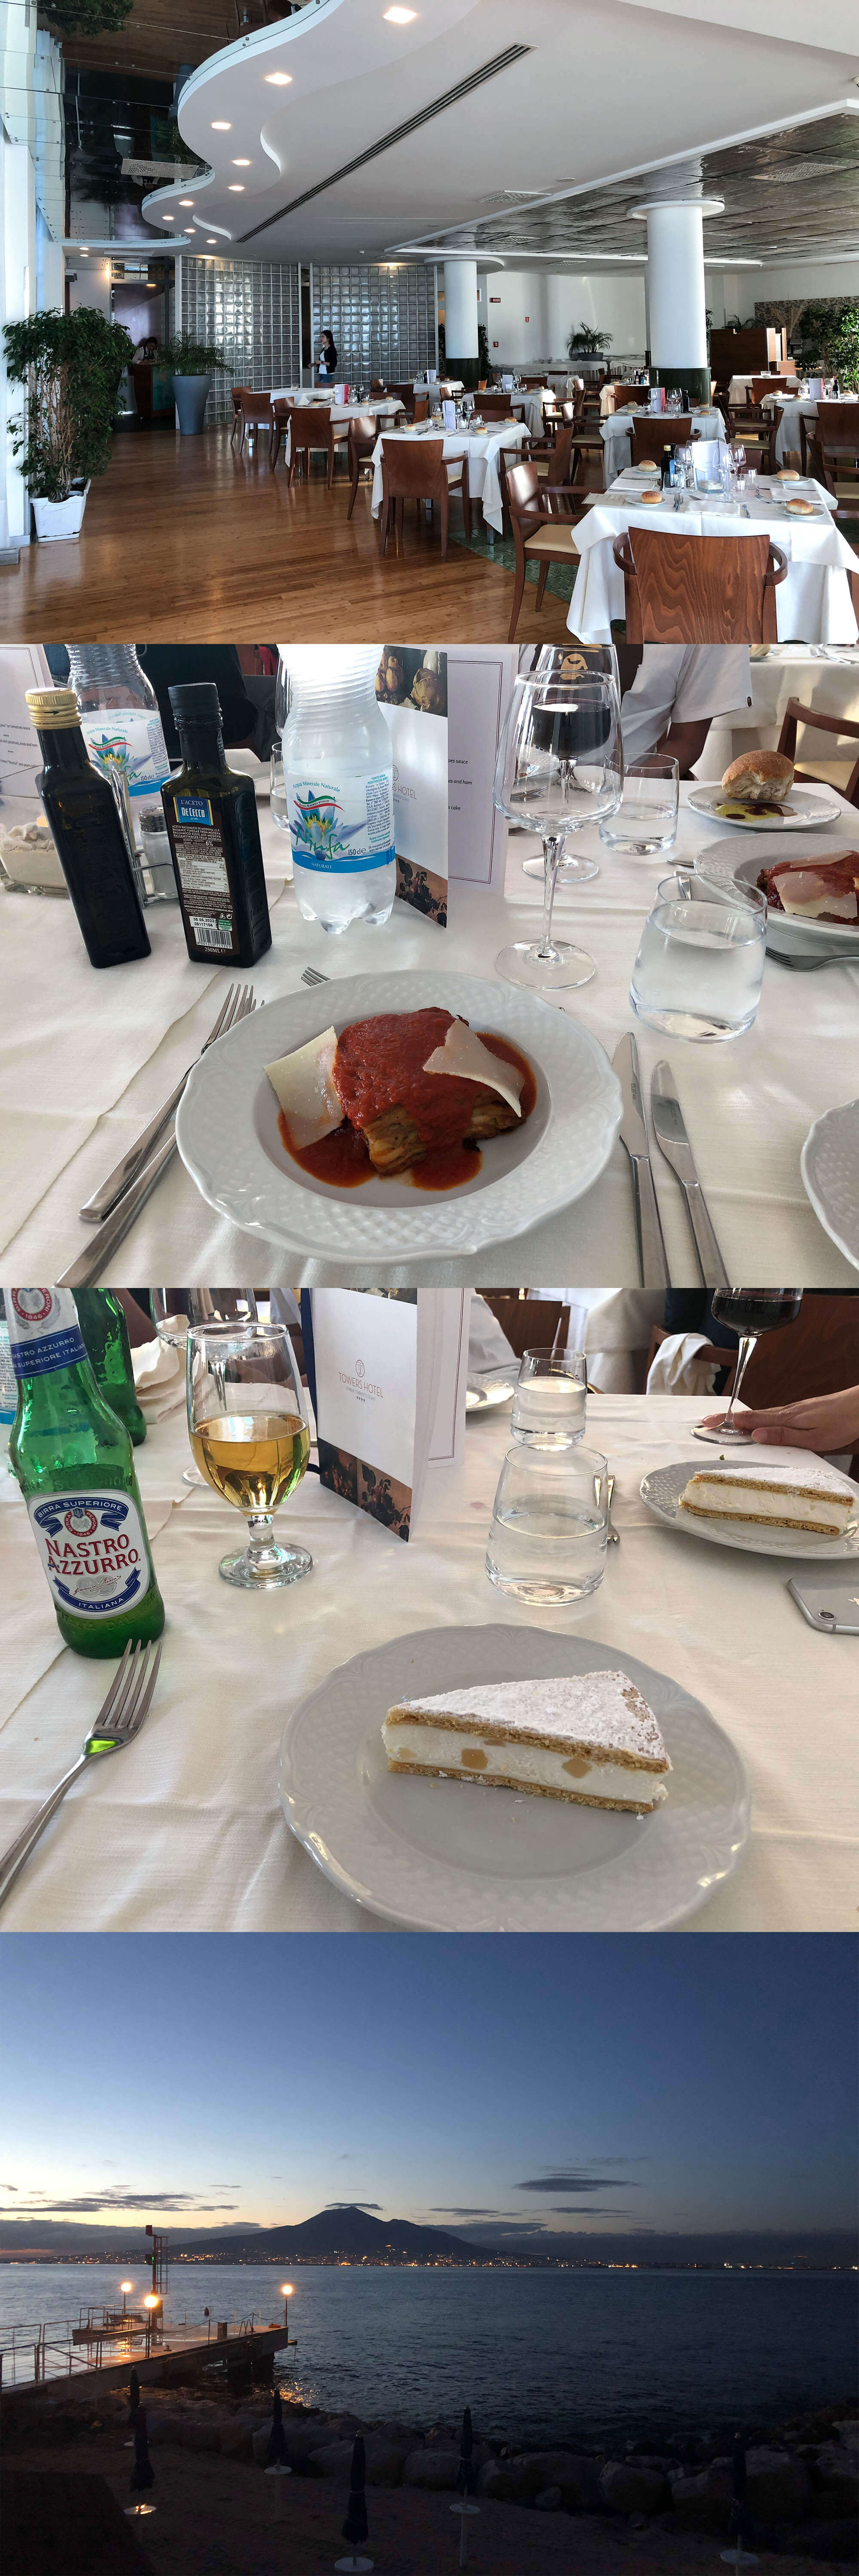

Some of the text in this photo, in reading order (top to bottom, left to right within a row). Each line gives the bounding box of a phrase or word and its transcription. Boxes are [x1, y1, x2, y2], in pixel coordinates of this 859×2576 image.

[321, 783, 340, 793] Naturale
[398, 784, 417, 800] HOTEL
[296, 825, 350, 860] Ninfa
[41, 1288, 51, 1312] ERONI
[13, 1337, 74, 1358] ASTRO AZZURRO
[18, 1343, 85, 1368] SUPERIORE ITALIAN
[338, 1372, 384, 1398] TOWERS HOTEL
[38, 1501, 122, 1518] BIRRA SUPERIORE
[86, 1512, 97, 1530] PERONI
[45, 1534, 130, 1558] NASTRO
[79, 1598, 124, 1610] ITALIANA
